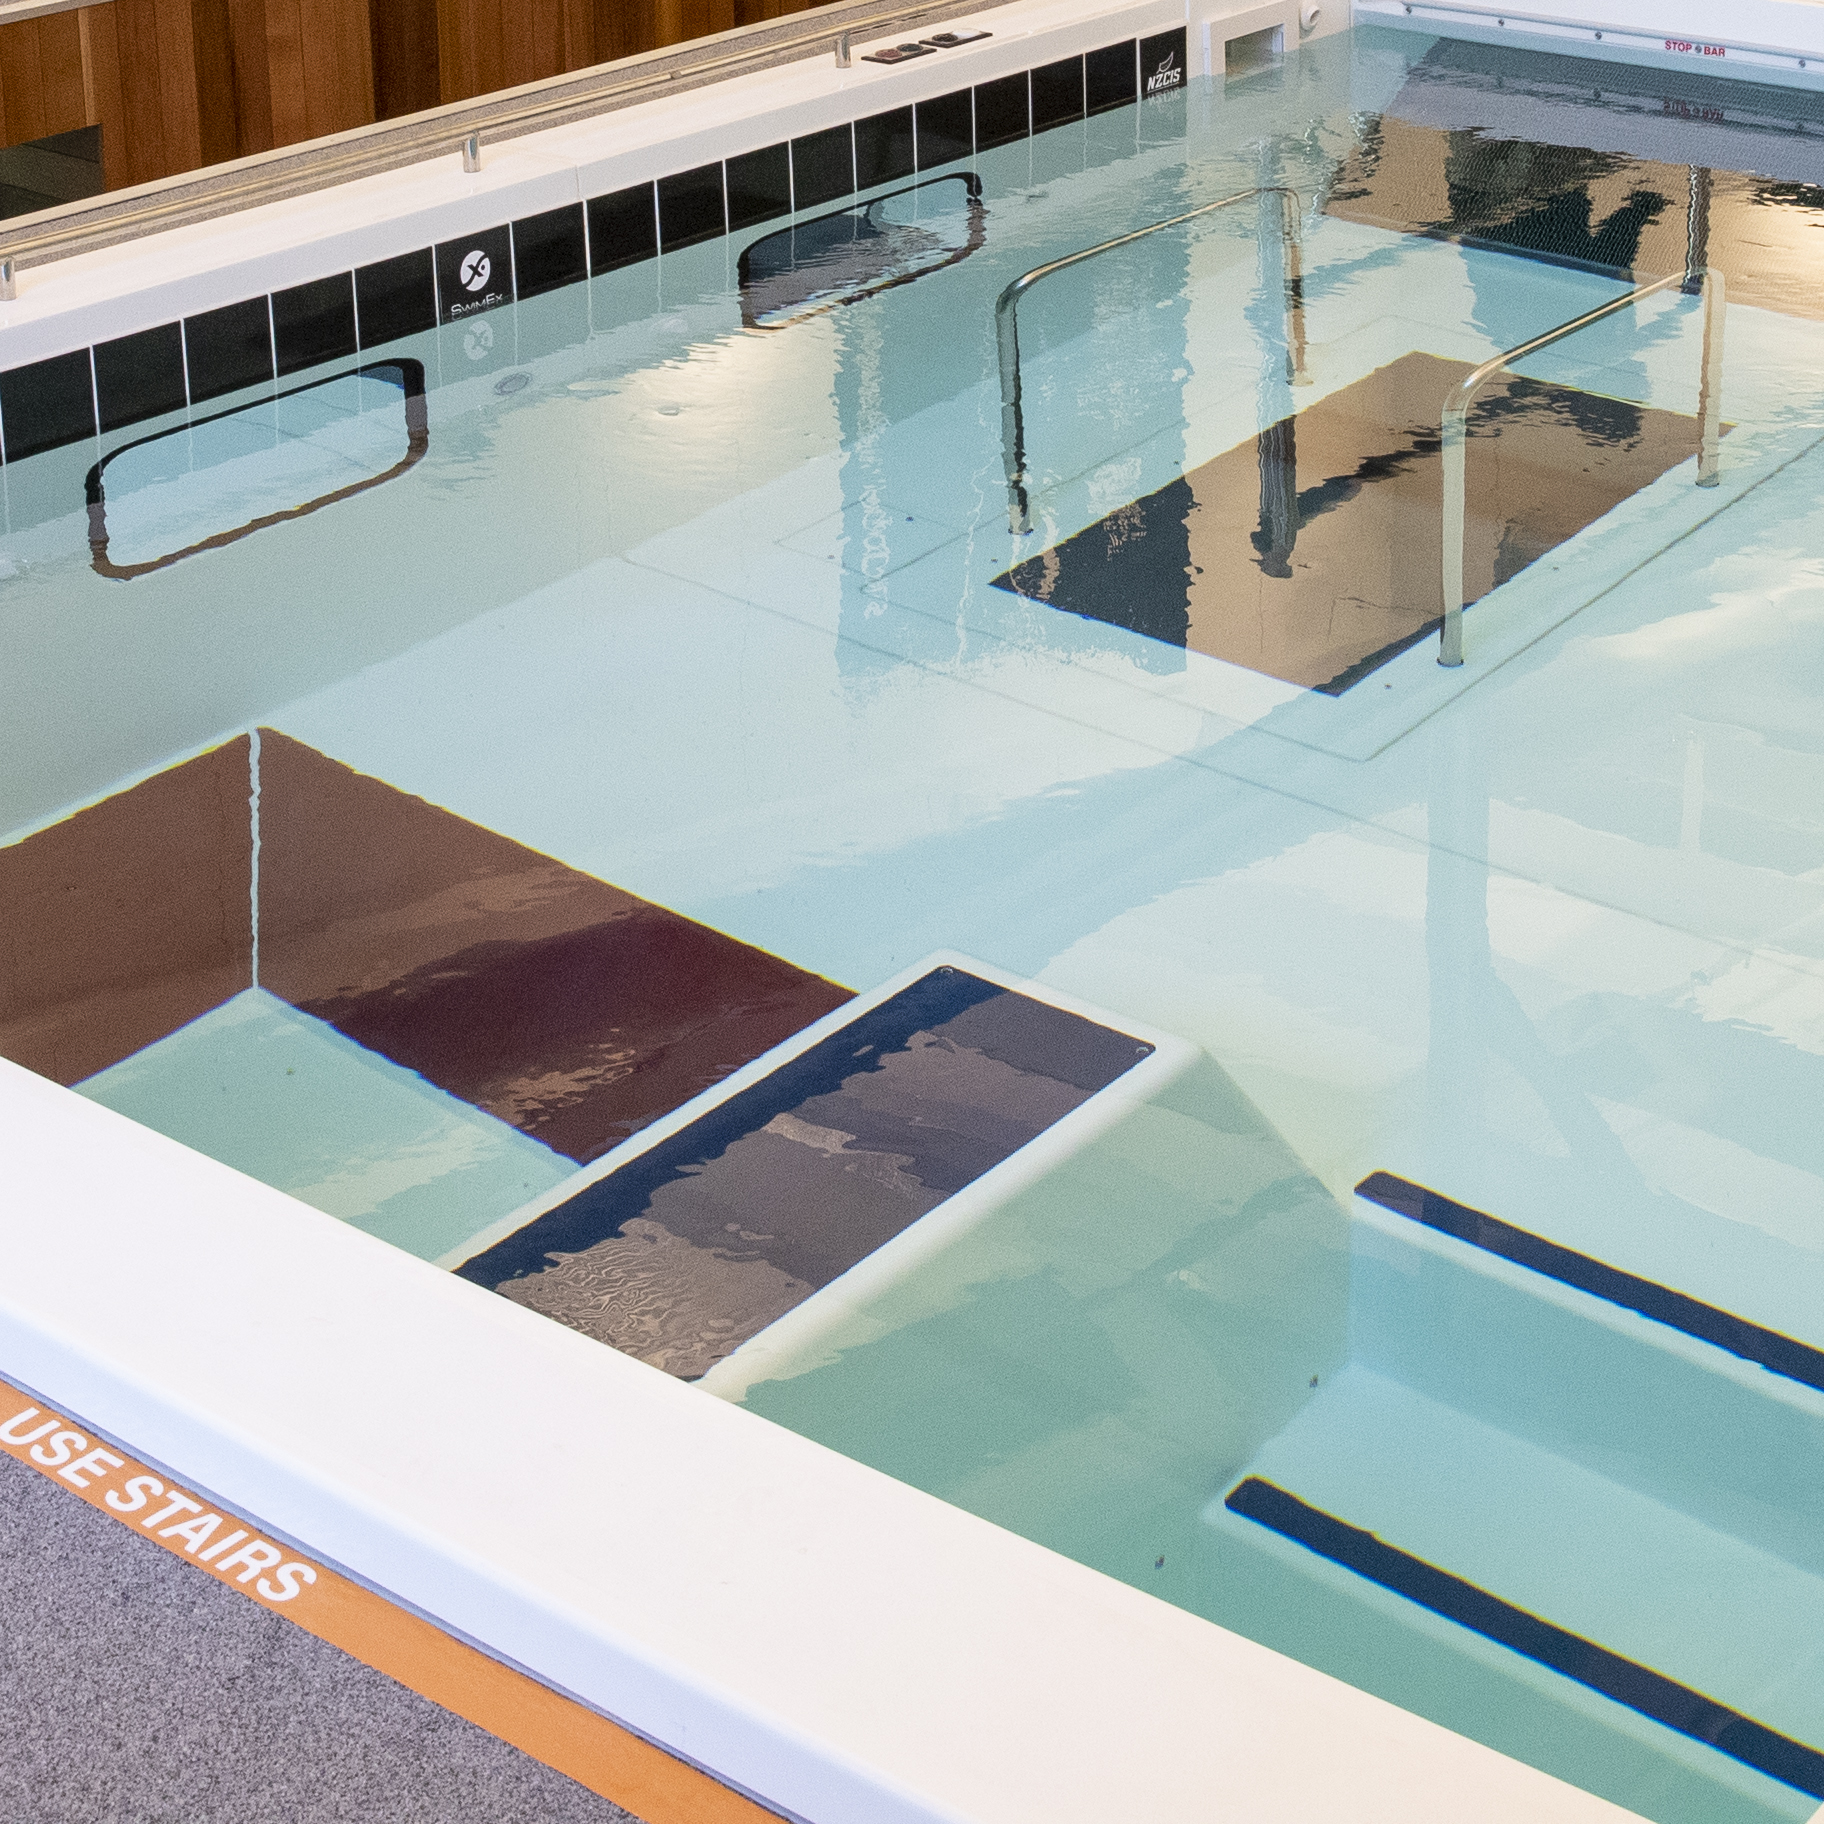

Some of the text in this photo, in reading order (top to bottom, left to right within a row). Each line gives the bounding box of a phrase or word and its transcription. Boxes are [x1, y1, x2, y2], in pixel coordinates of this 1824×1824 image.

[1665, 40, 1726, 57] STOP BAR
[1147, 67, 1182, 92] NZCIS
[103, 1475, 318, 1603] STAIRS
